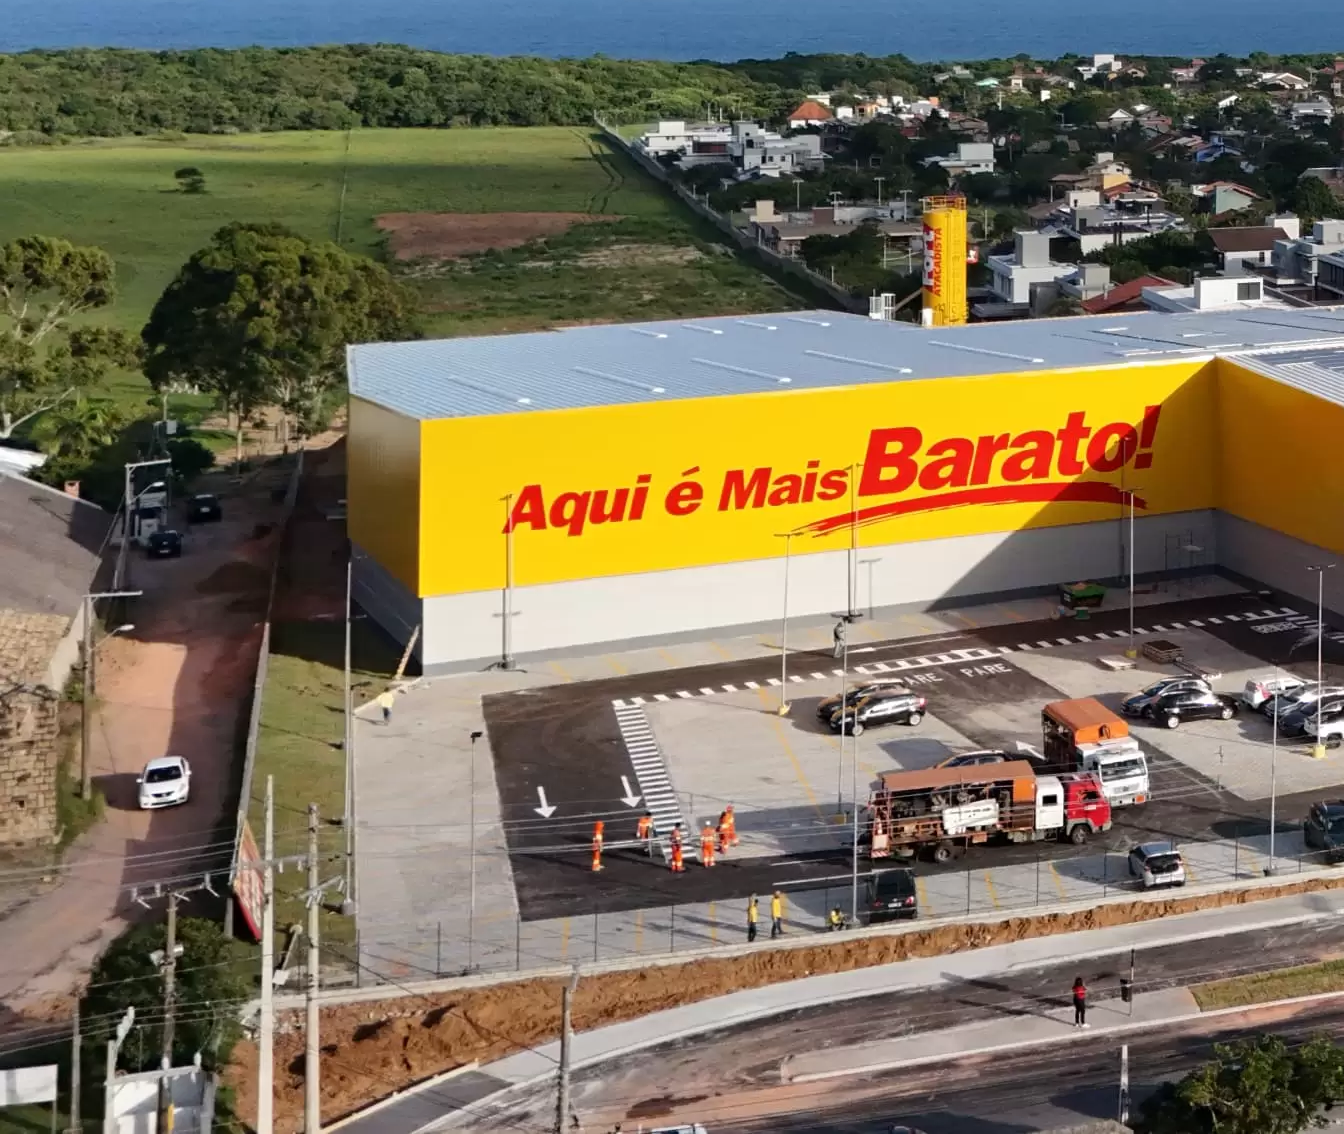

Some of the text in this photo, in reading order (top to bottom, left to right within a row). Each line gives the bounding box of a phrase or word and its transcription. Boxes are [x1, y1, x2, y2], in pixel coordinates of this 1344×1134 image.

[933, 227, 942, 297] ATACADISTA
[502, 404, 1162, 537] Aqui é Mais Barato!
[902, 672, 944, 686] ARE
[959, 663, 1012, 678] PARE
